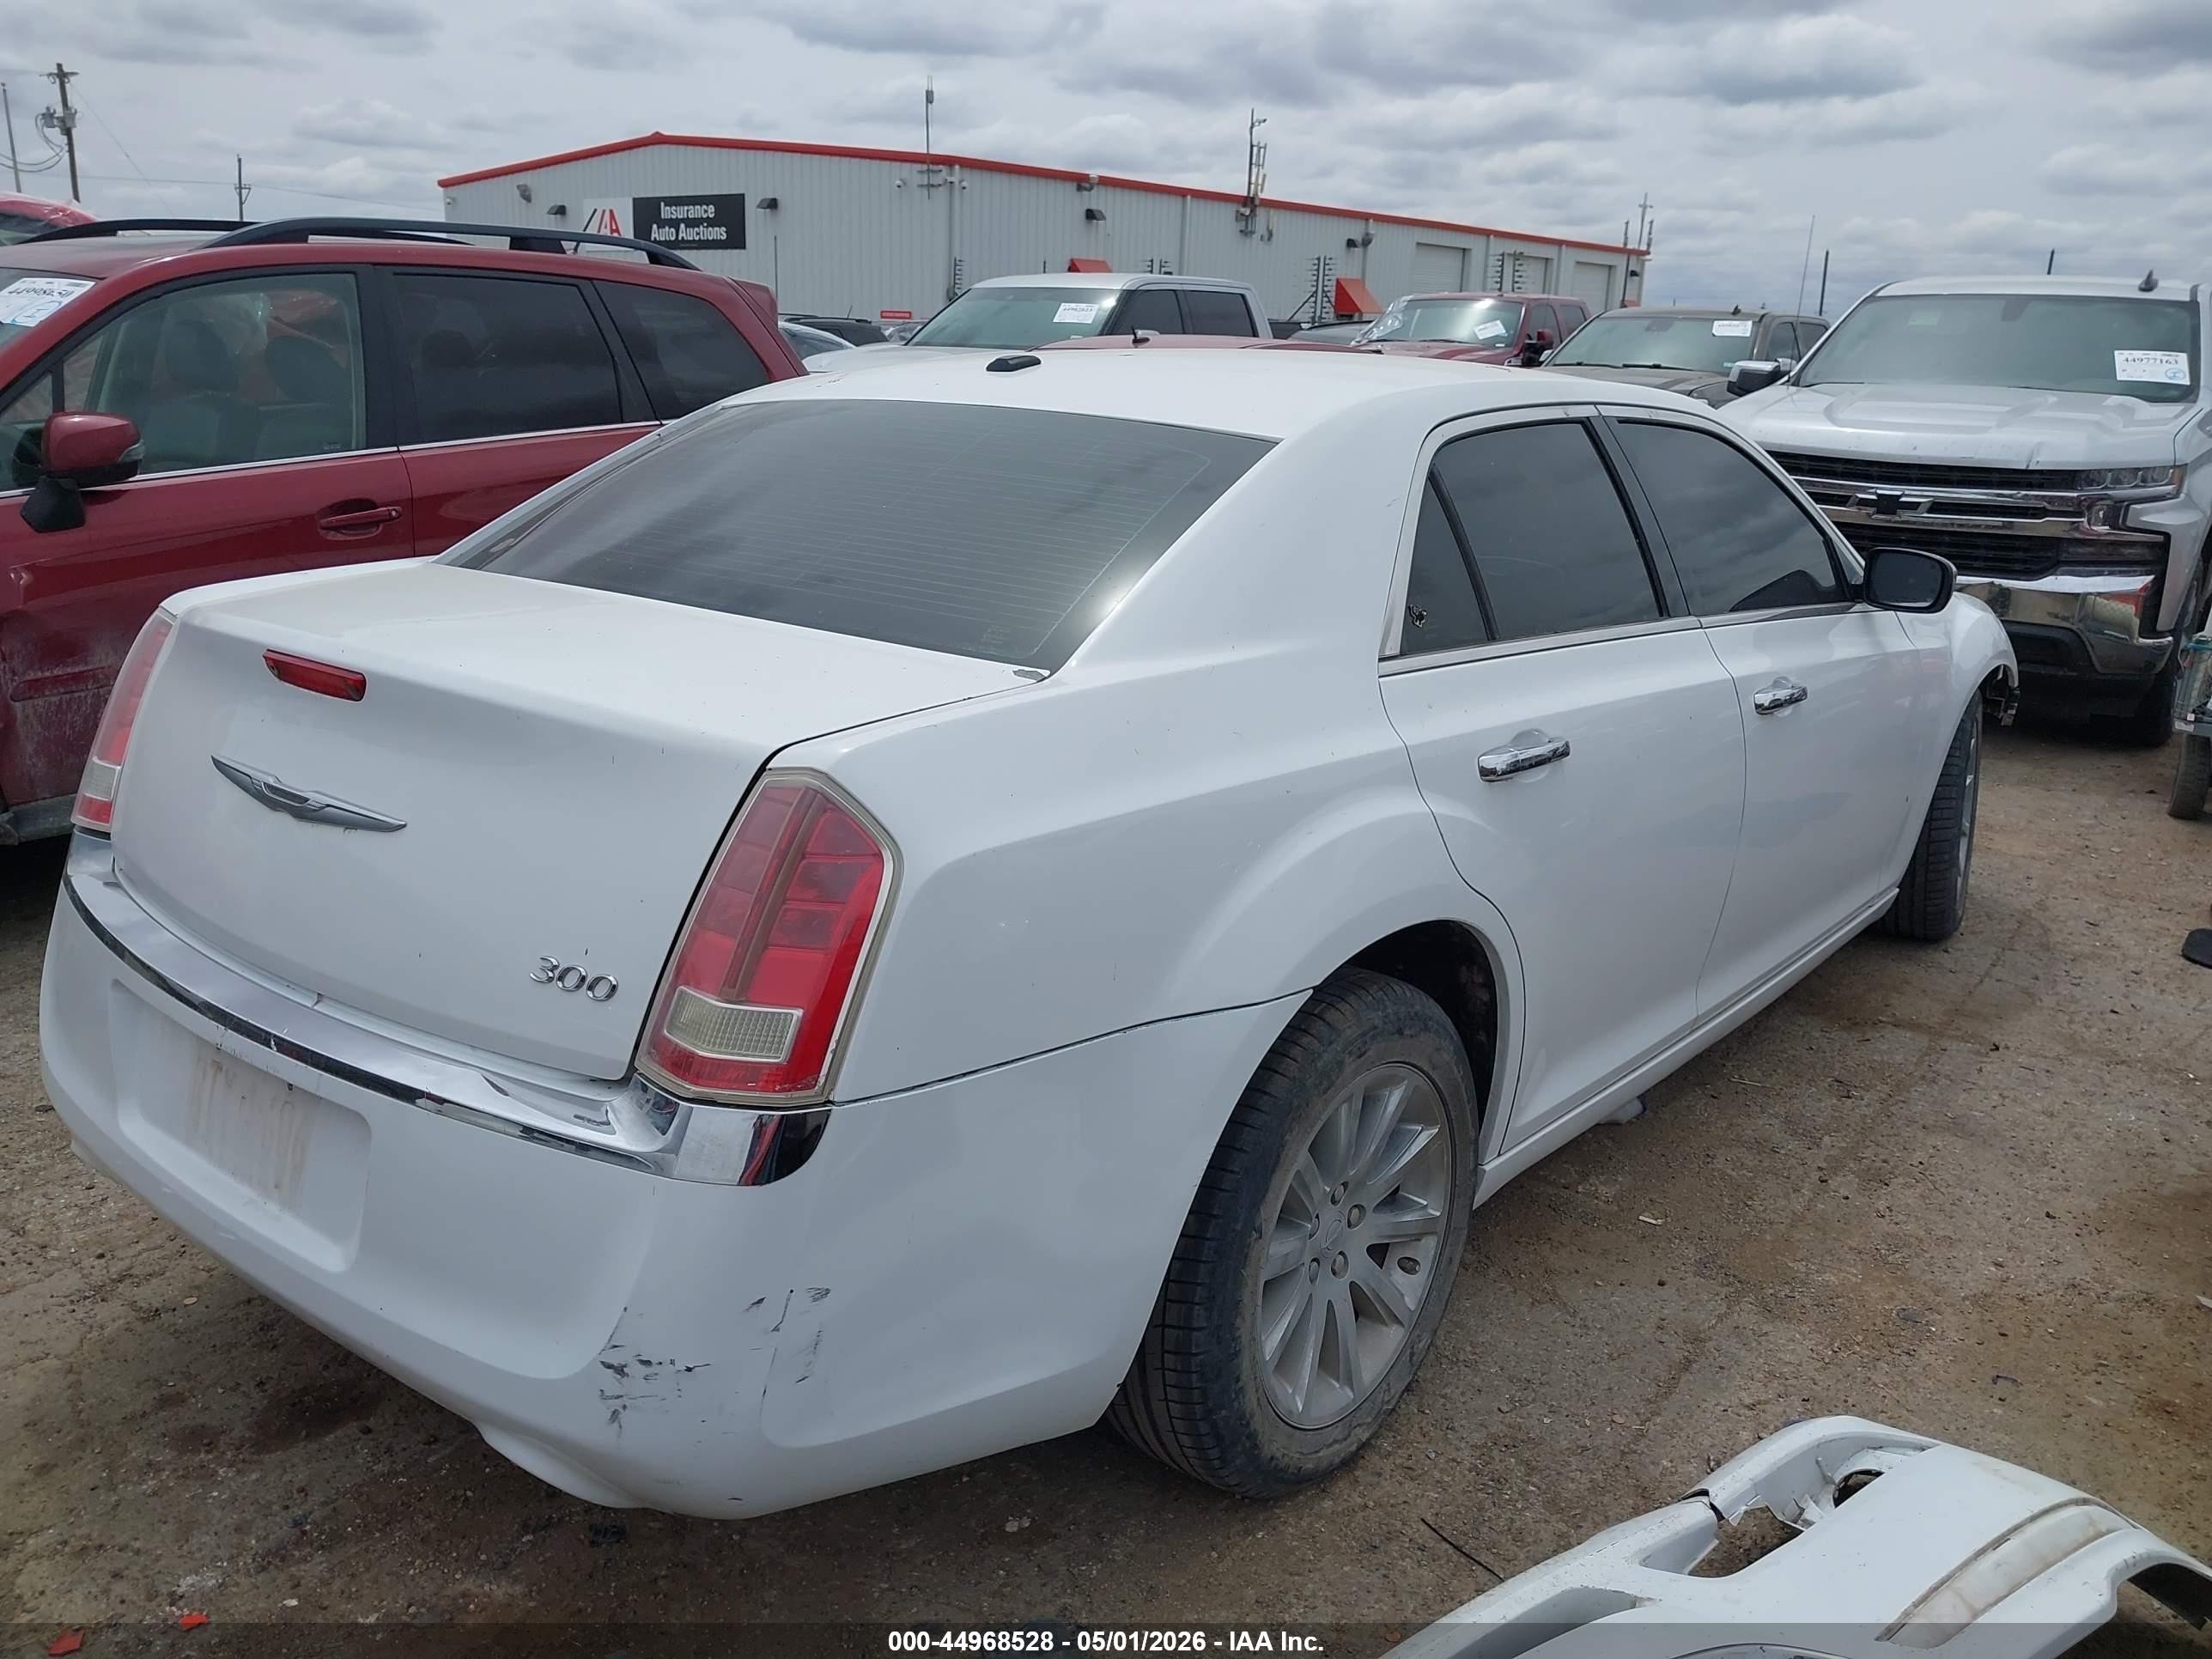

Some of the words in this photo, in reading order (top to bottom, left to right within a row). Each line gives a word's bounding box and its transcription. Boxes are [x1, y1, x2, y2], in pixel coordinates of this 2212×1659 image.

[660, 201, 715, 219] Insurance
[651, 223, 677, 241] Auto
[678, 222, 727, 240] Auctions
[2122, 356, 2179, 365] 44977163
[529, 956, 619, 1002] 300
